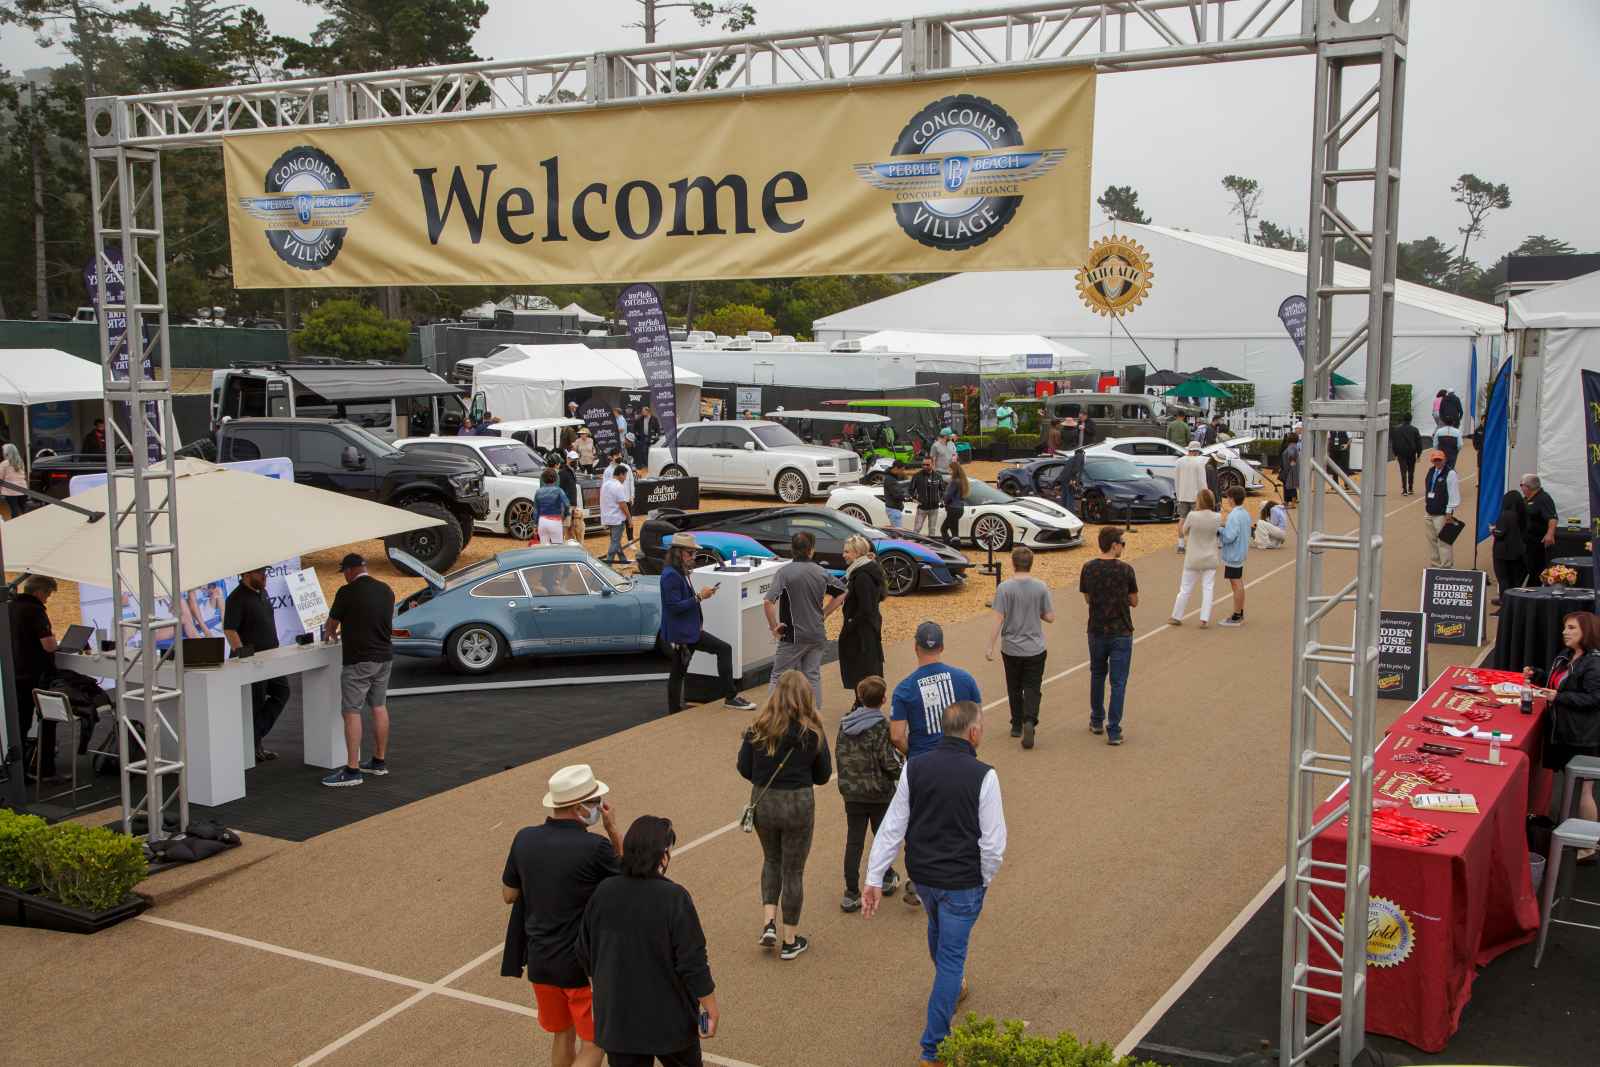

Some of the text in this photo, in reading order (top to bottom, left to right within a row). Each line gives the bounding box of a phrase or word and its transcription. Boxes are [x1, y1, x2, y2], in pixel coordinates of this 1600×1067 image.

[912, 109, 1006, 145] CONCOURS
[274, 157, 337, 185] CONCOURS
[888, 155, 1020, 178] PEBBLE BEACH
[412, 154, 809, 246] Welcome
[912, 206, 1000, 239] VILLAGE
[283, 234, 336, 262] VILLAGE
[647, 491, 680, 503] REGISTRY
[1432, 590, 1468, 599] HOUSE
[1433, 583, 1474, 592] HIDDEN
[1432, 597, 1473, 607] COFFEE
[1379, 627, 1414, 638] DDEN
[917, 671, 952, 687] FREEDOM
